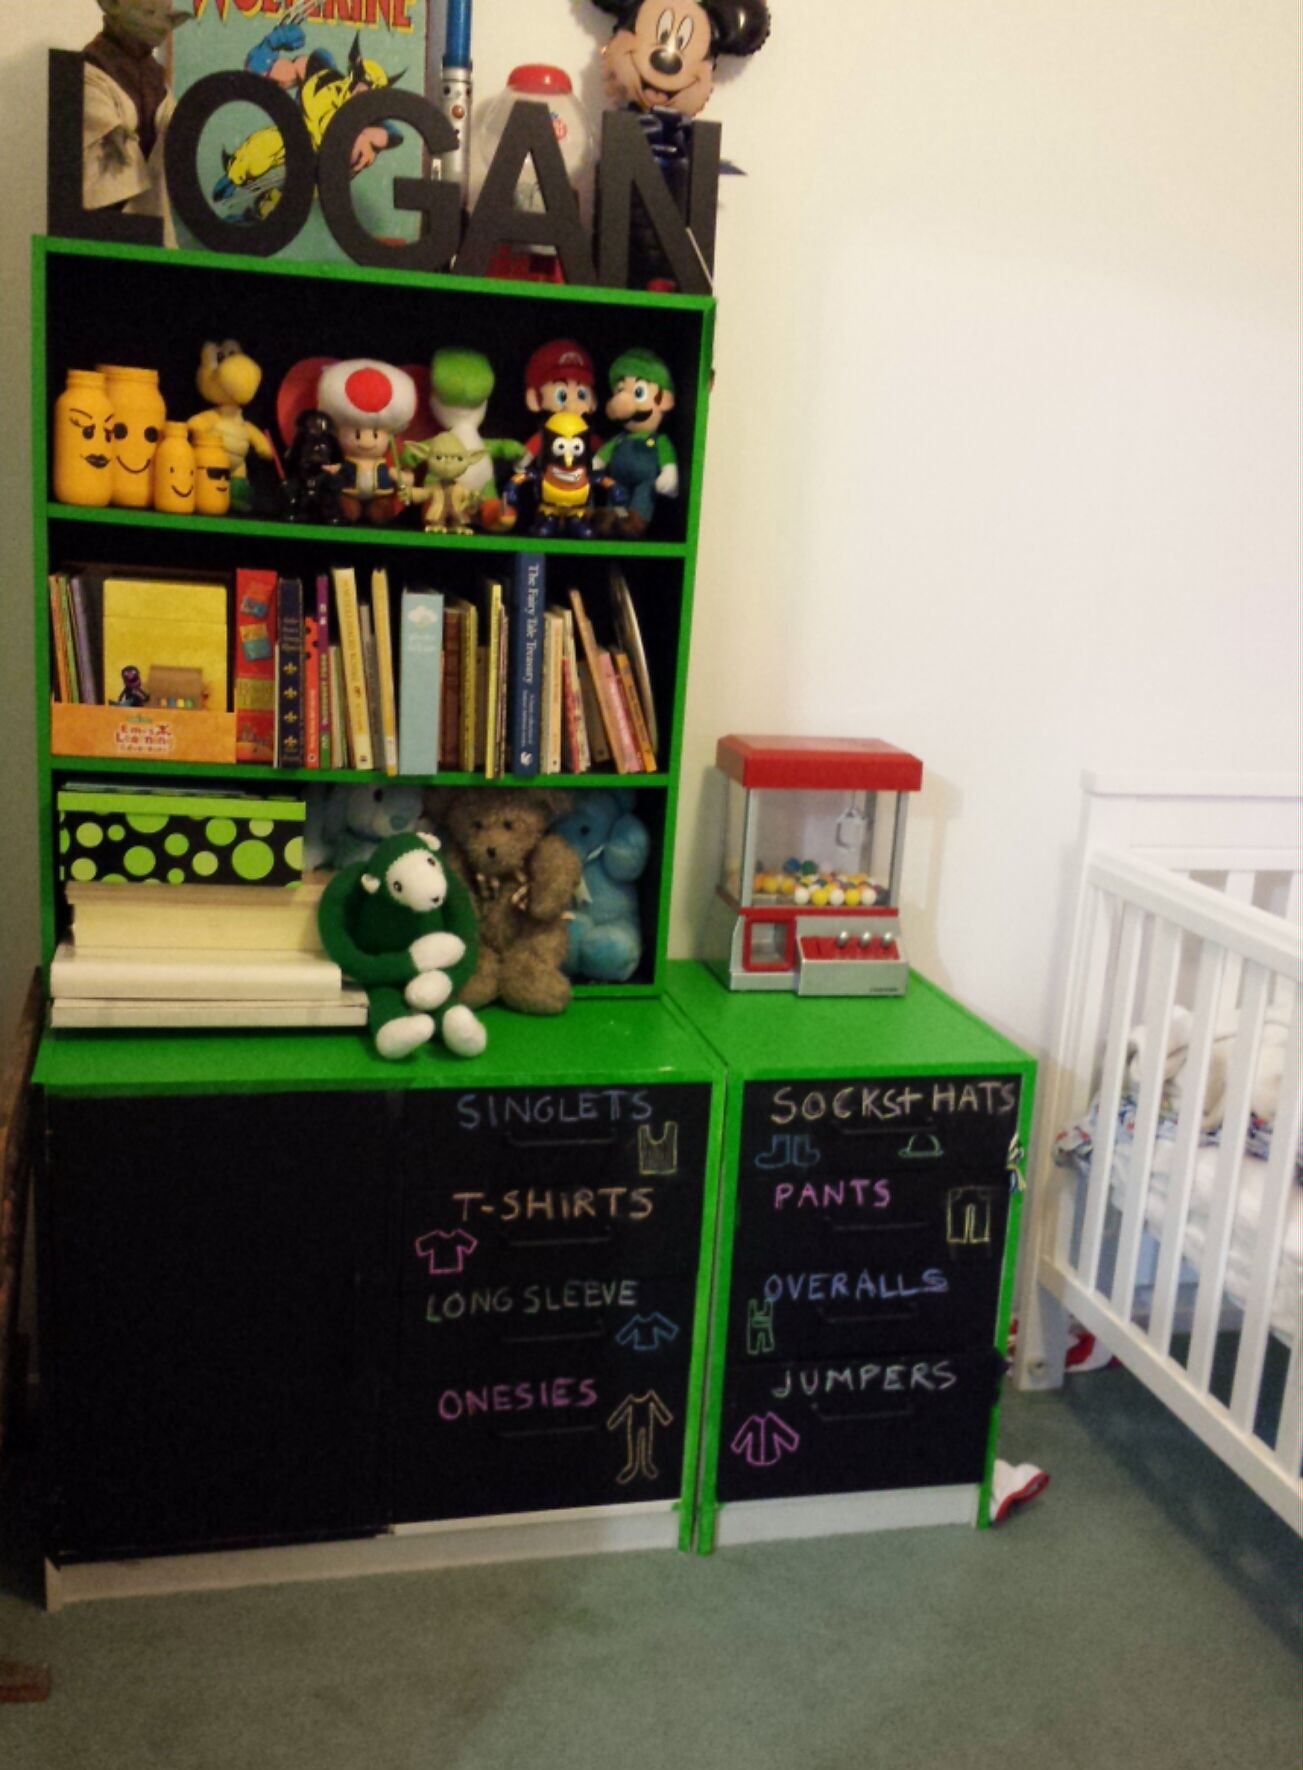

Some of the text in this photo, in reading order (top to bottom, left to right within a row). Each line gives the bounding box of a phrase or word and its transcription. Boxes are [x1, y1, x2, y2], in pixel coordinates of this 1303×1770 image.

[48, 48, 721, 294] LOGAN
[527, 561, 540, 587] The
[524, 588, 539, 615] Fairy
[526, 616, 538, 639] Tale
[522, 640, 537, 685] Treasury
[457, 1089, 654, 1130] SINGLETS
[932, 1081, 1017, 1115] HATS
[774, 1178, 892, 1210] PANTS
[425, 1279, 639, 1322] LONG SLEEVE
[763, 1267, 949, 1303] OVERALLS
[772, 1360, 957, 1398] JUMPERS
[437, 1378, 598, 1421] ONESIES
